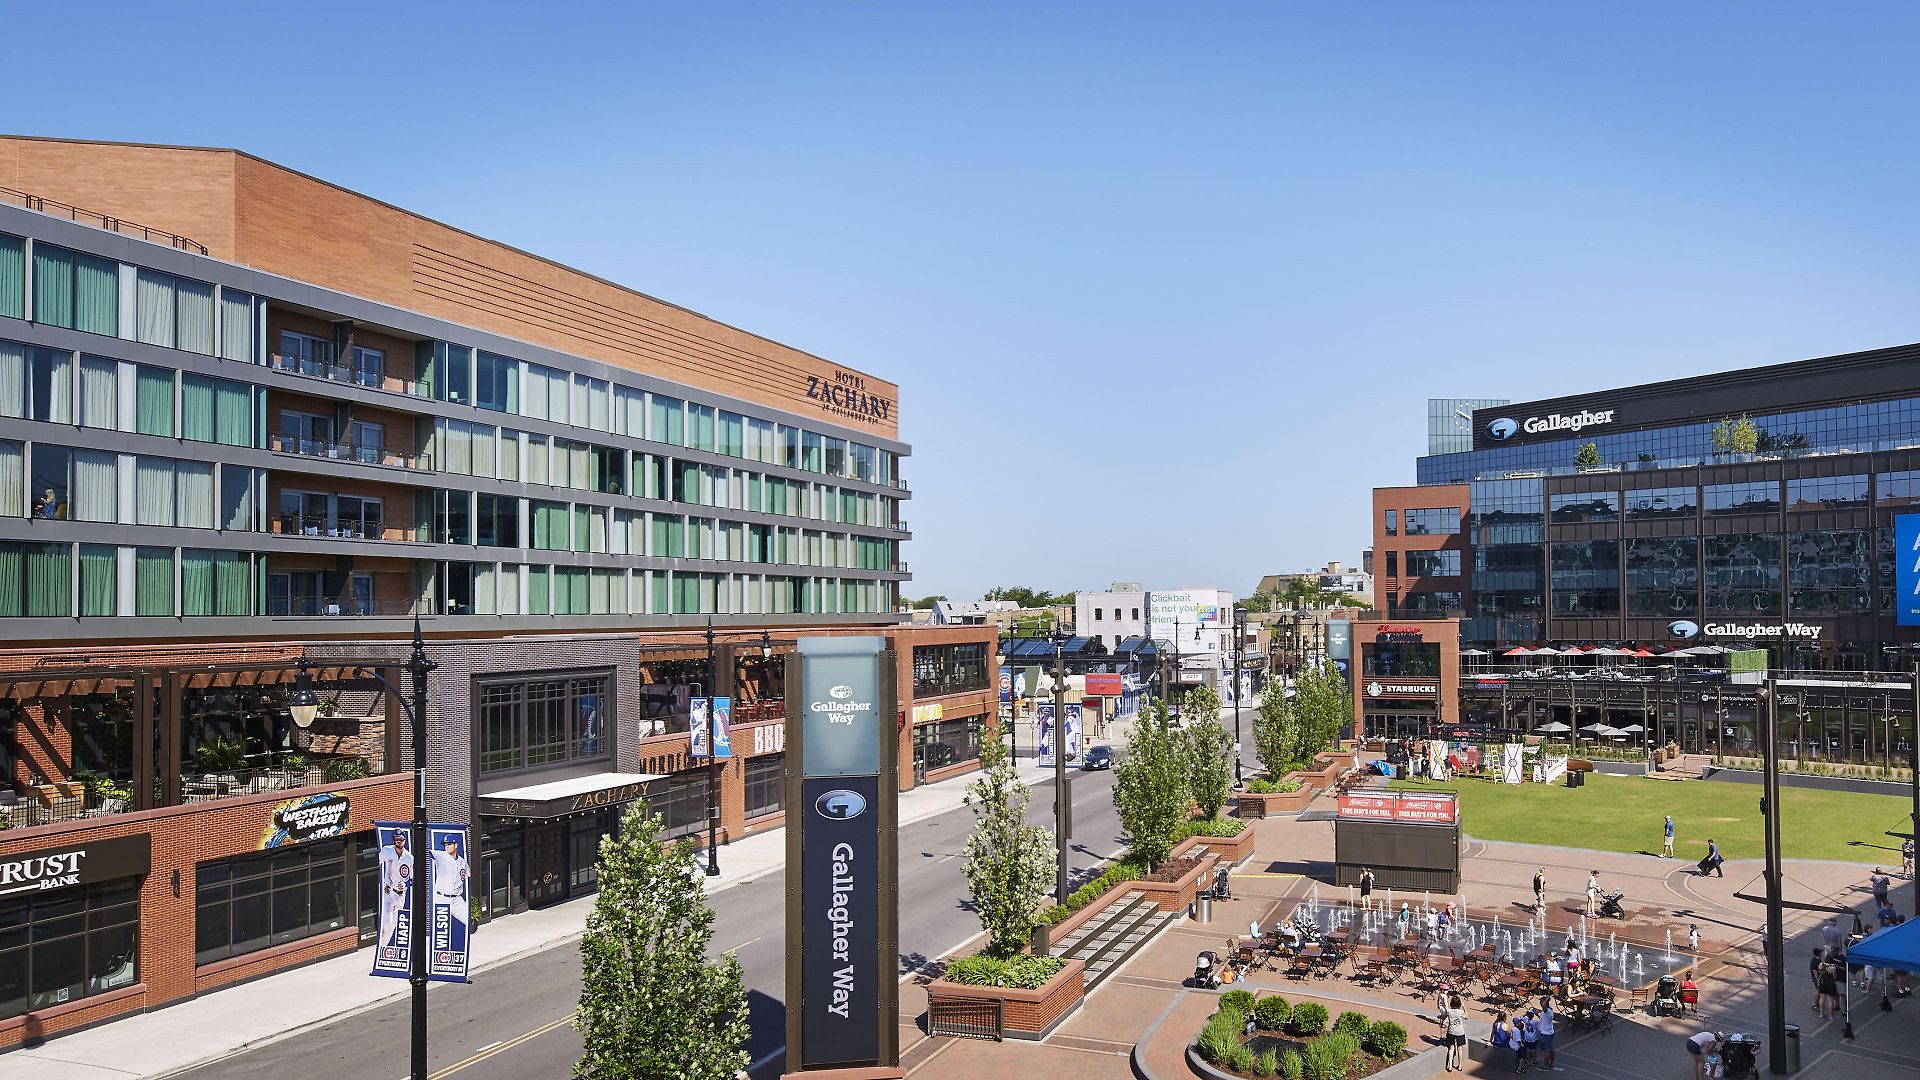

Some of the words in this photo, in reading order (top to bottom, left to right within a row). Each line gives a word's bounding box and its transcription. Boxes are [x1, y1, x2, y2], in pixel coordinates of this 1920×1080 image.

[835, 370, 865, 390] HOTEL
[807, 376, 890, 419] ZACHARY
[1524, 410, 1614, 433] Gallagher
[1152, 594, 1191, 602] Clickbait
[1152, 604, 1159, 612] is
[1179, 605, 1200, 613] your
[1704, 623, 1783, 638] Gallagher
[1785, 623, 1822, 639] Way
[1387, 685, 1436, 693] STARBUCKS
[811, 701, 871, 713] Gallagher
[828, 713, 855, 725] Way
[571, 783, 650, 810] ZACHARY
[296, 813, 341, 830] BAKERY
[0, 851, 86, 885] RUST
[40, 874, 80, 890] BANK
[828, 842, 854, 961] Gallagher
[398, 913, 409, 945] HAPP
[436, 907, 449, 948] WILSON
[400, 950, 407, 959] 8
[455, 954, 464, 962] 37
[828, 964, 853, 1018] Way
